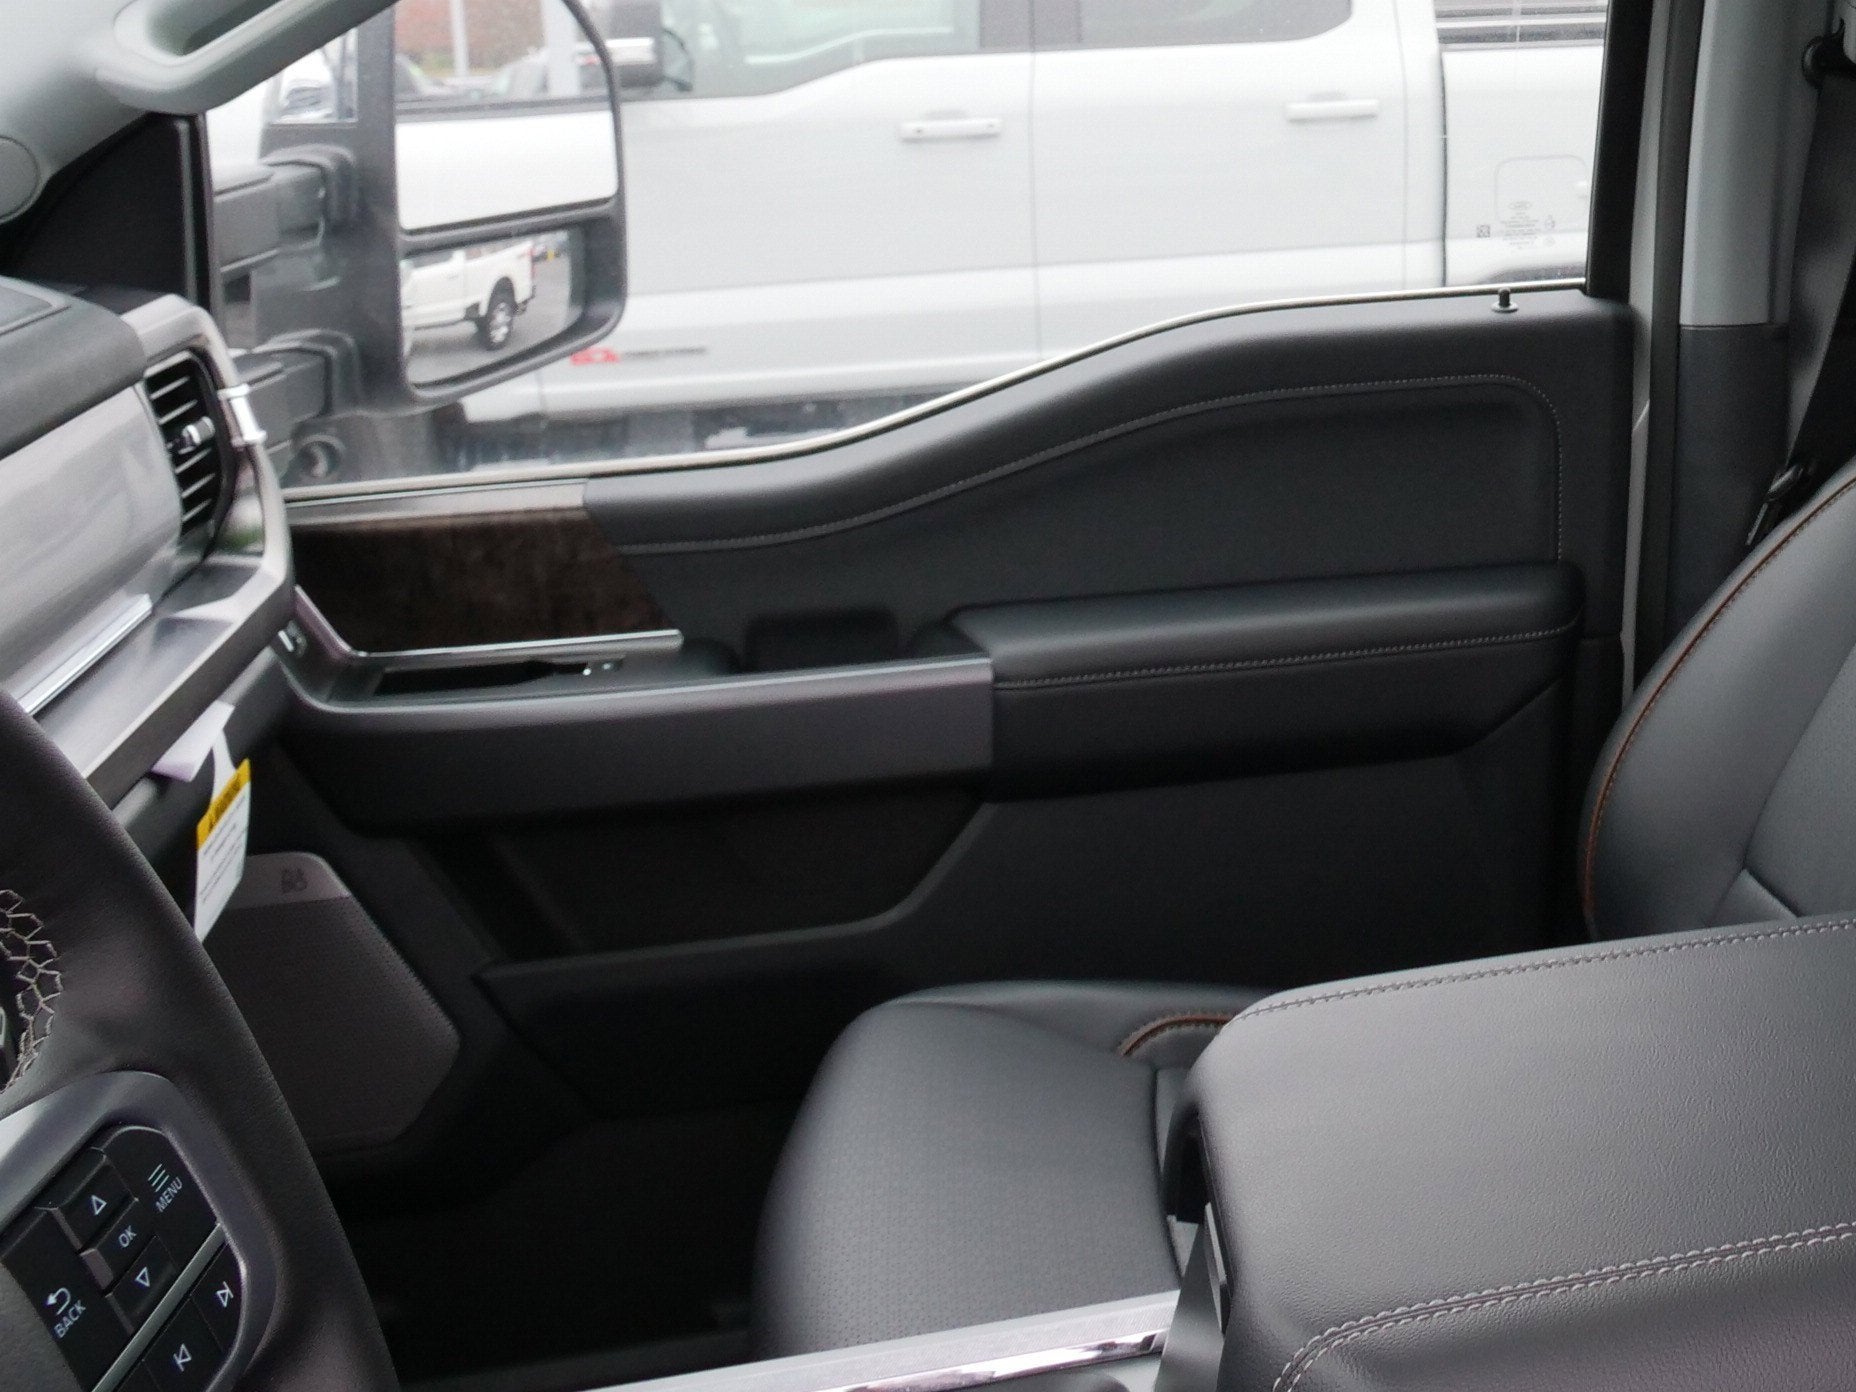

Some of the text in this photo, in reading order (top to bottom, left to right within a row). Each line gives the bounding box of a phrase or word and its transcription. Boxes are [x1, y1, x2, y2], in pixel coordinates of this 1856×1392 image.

[155, 1177, 184, 1213] MENU
[118, 1225, 137, 1248] OK
[54, 1300, 86, 1339] BACK
